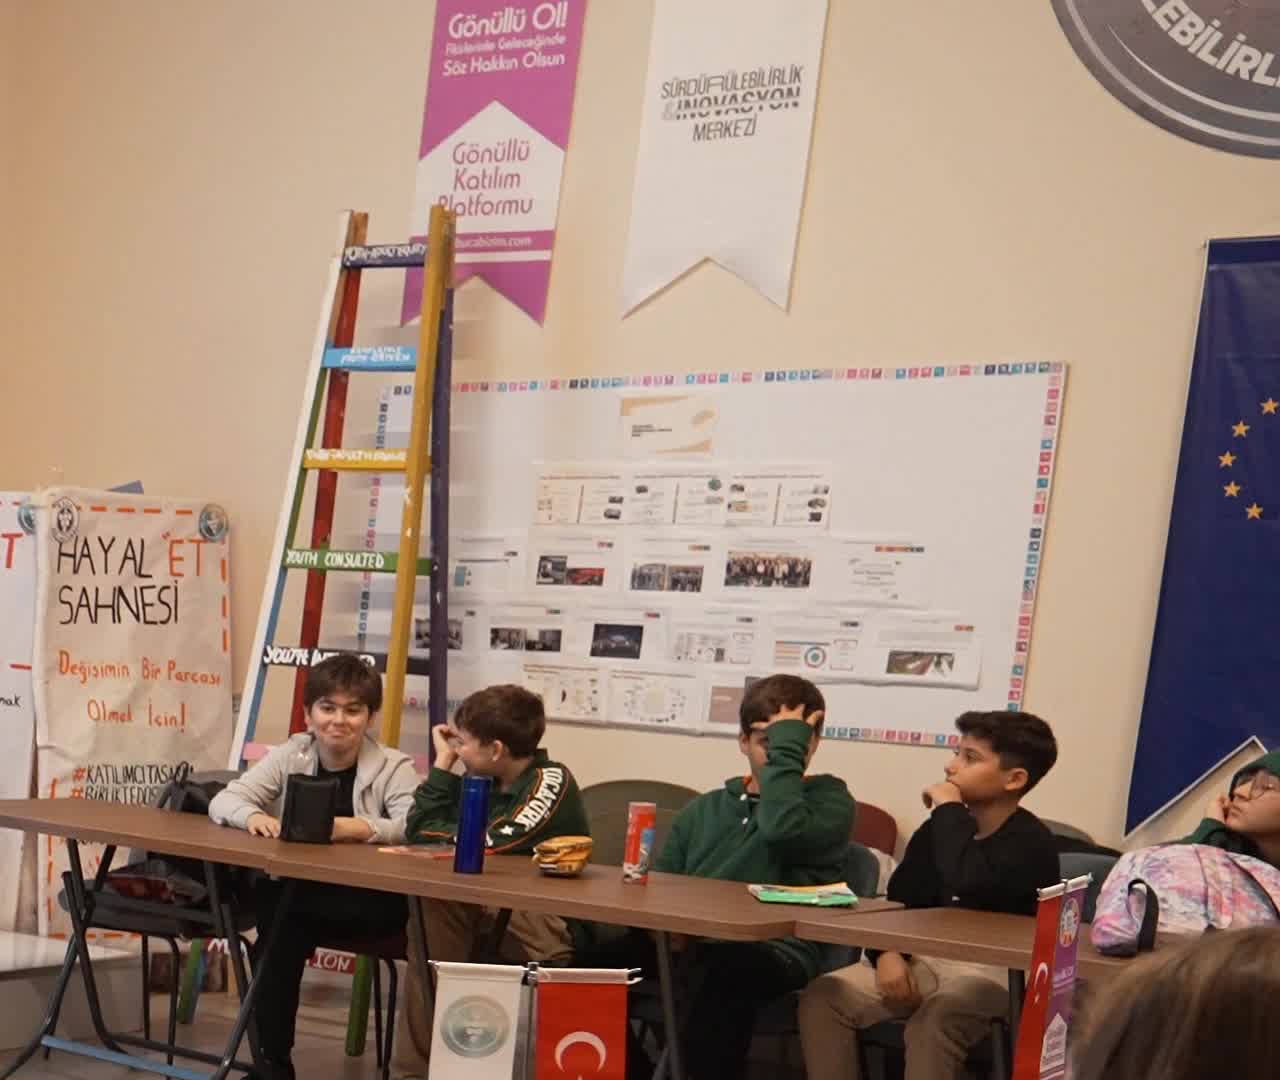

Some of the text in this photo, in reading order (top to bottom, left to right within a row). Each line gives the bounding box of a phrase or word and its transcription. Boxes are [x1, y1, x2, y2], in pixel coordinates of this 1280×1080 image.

[448, 1, 568, 39] Gönüllü Ol!
[1140, 0, 1280, 88] EBİLİRL
[442, 51, 565, 76] Söz Hakkın Olsun
[452, 137, 530, 165] Gönüllü
[453, 166, 521, 191] Katılım
[438, 192, 534, 217] Platformu
[57, 535, 153, 578] HAYAL
[286, 550, 385, 569] YOUTH CONSULTED
[58, 579, 179, 626] SAHNESİ
[141, 656, 161, 680] Bir
[263, 645, 310, 667] YOUTH
